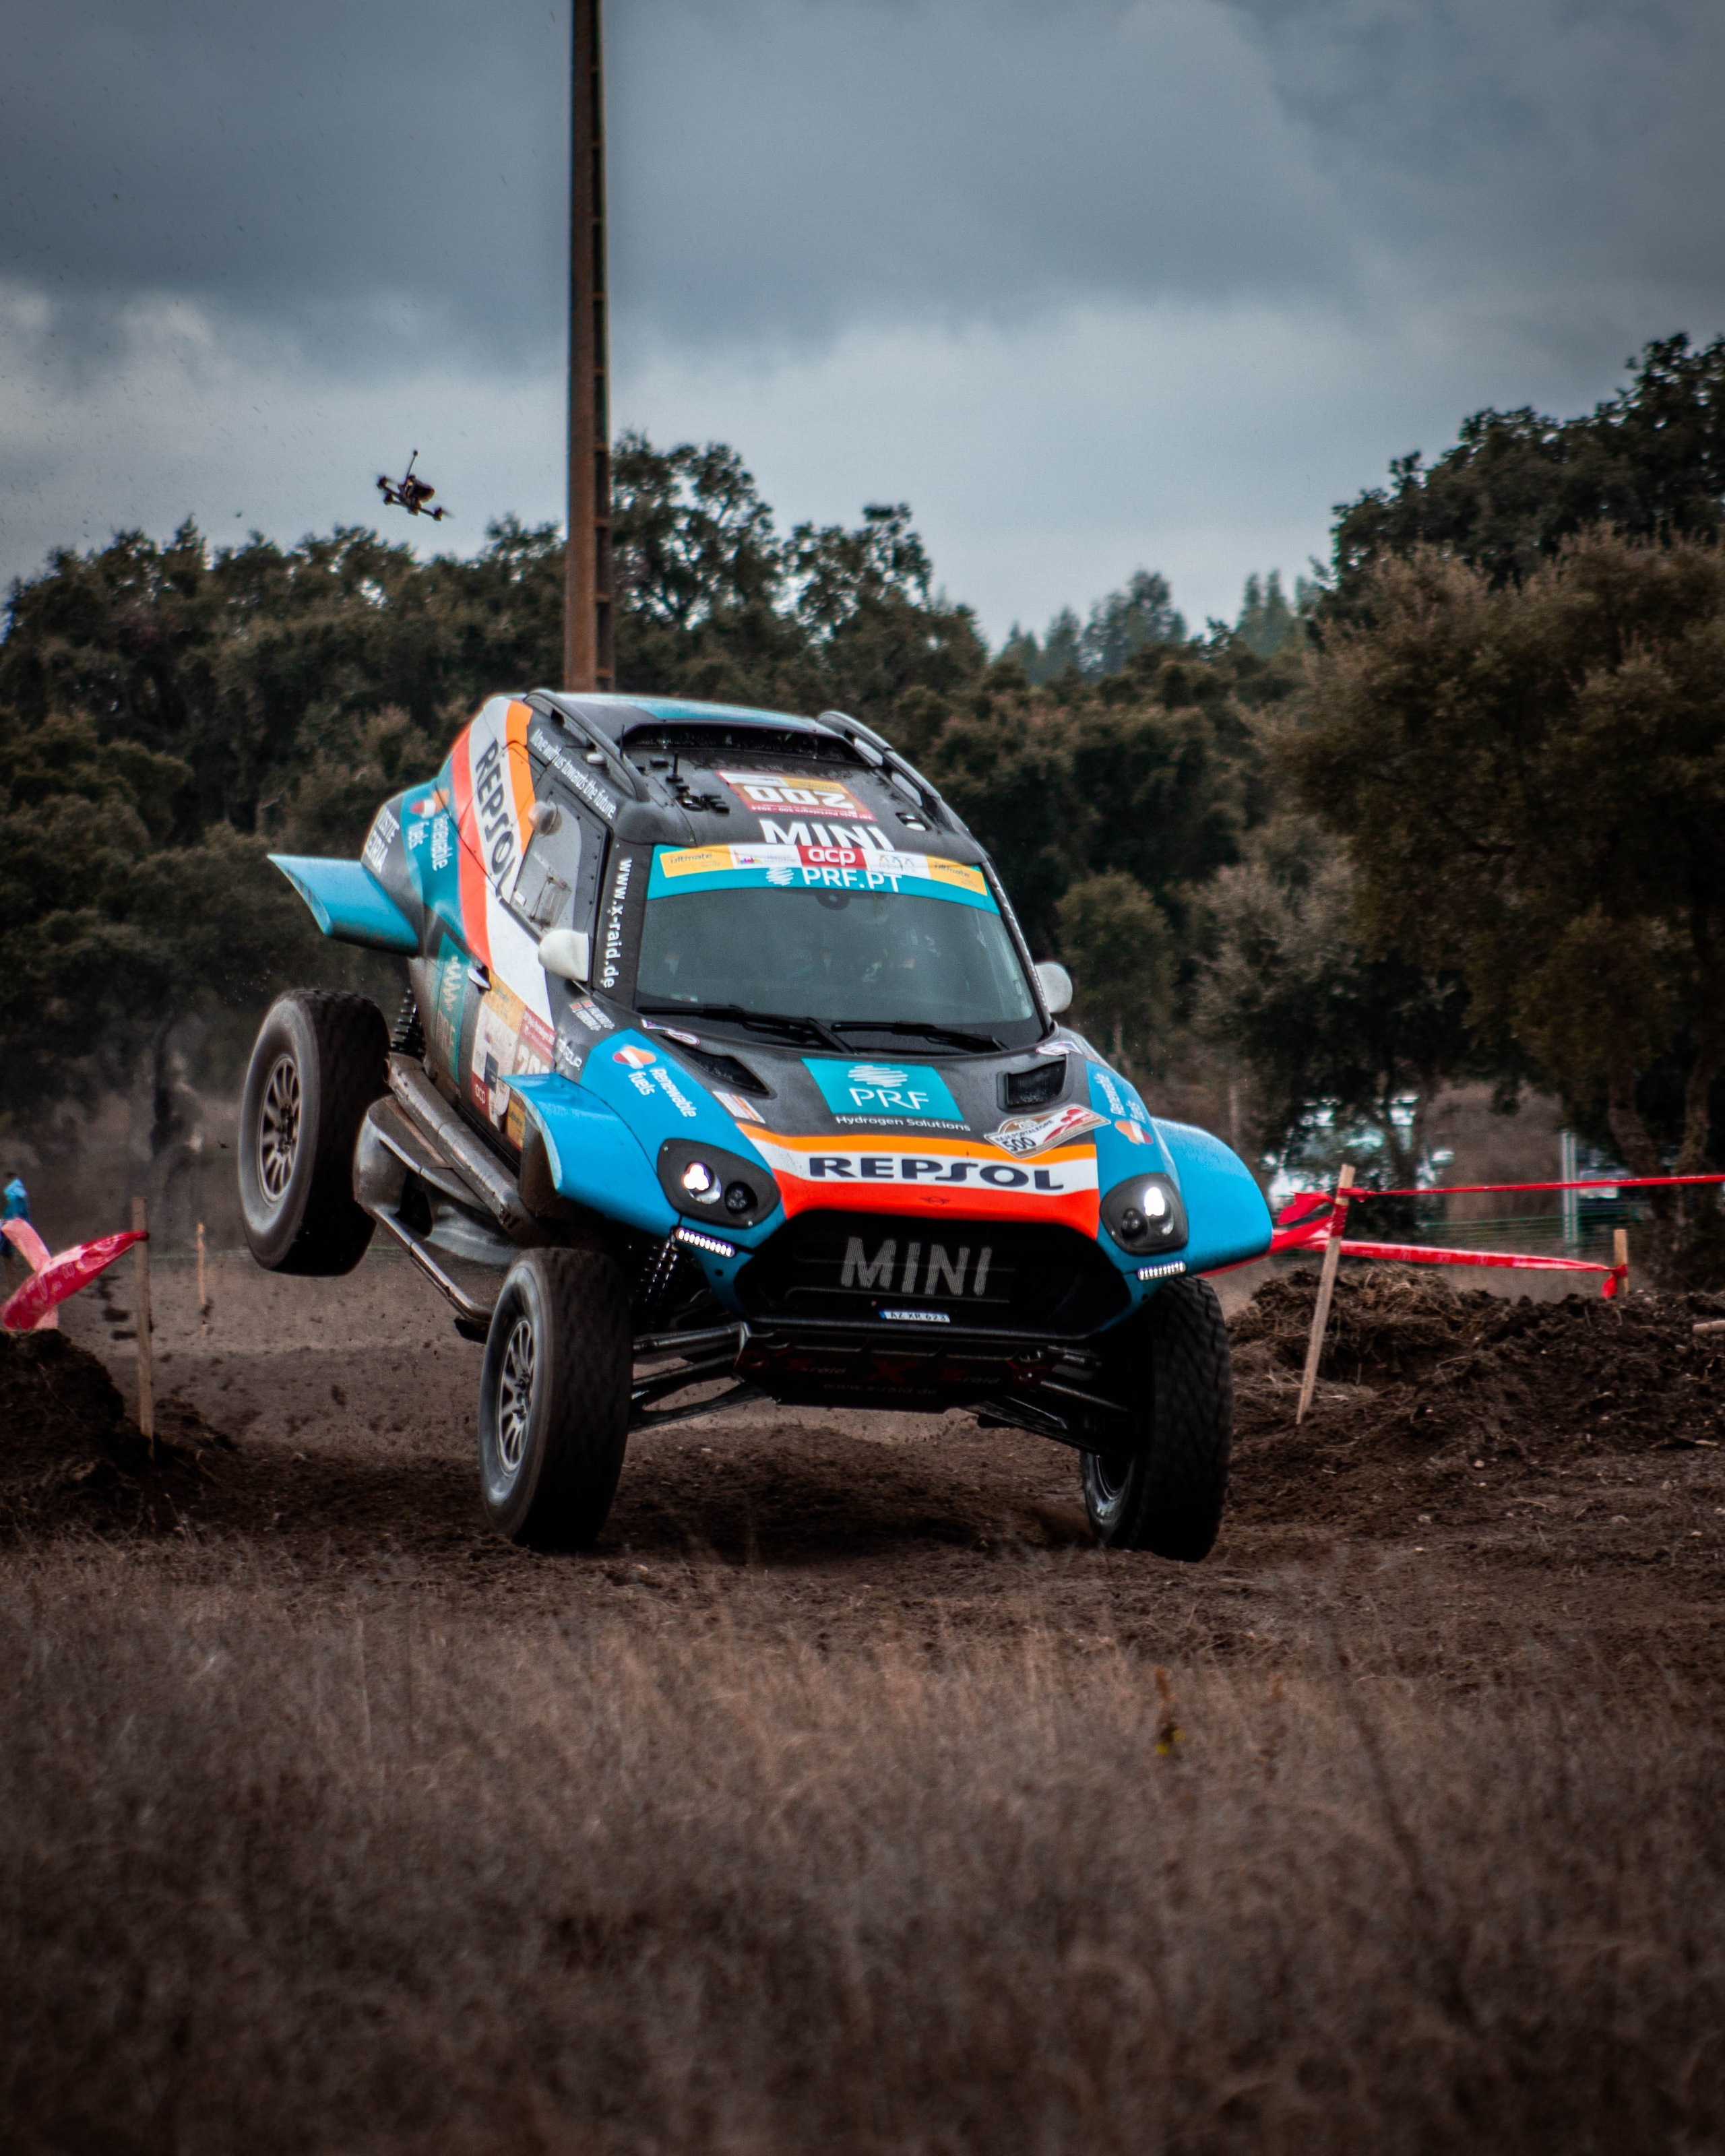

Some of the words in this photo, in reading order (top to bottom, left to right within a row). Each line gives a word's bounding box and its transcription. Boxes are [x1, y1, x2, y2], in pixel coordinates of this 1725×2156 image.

[584, 780, 598, 800] the
[744, 785, 854, 809] 200
[476, 739, 516, 899] REPSOL
[759, 819, 896, 852] MINI
[808, 848, 856, 866] acp
[802, 866, 902, 893] PRF.PT
[602, 858, 633, 988] www.x-raid.de
[628, 1070, 656, 1096] fuels
[648, 1067, 697, 1118] Renewable
[848, 1087, 929, 1110] PRF
[836, 1115, 904, 1127] Hydrogen
[907, 1118, 971, 1132] Solutions
[1001, 1137, 1037, 1152] 500
[809, 1157, 1065, 1191] REPSOL
[840, 1235, 993, 1296] MINI
